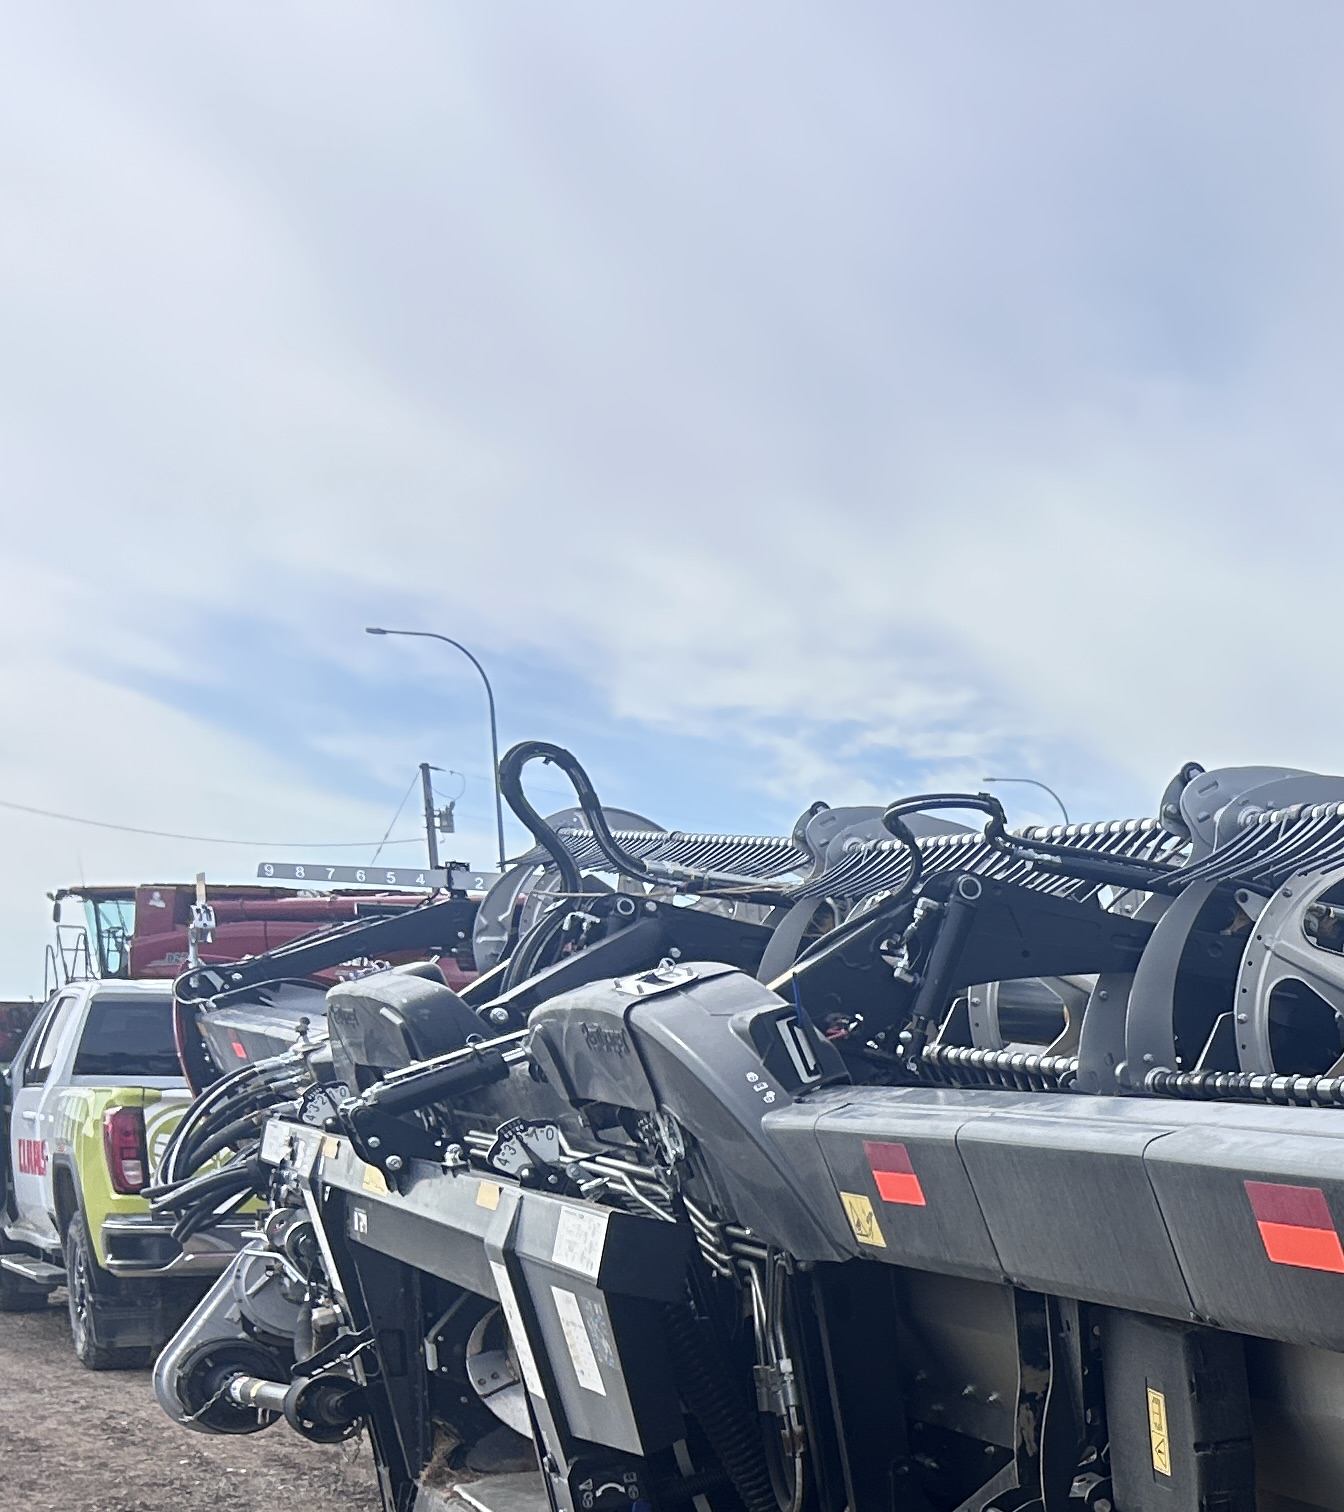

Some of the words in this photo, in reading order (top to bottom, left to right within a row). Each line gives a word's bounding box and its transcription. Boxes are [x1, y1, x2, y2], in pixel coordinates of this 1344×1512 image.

[264, 864, 275, 876] 9
[295, 866, 305, 878] 8
[325, 867, 336, 880] 7
[356, 869, 366, 882] 6
[386, 871, 396, 884] 5
[415, 873, 426, 885] 4
[474, 876, 484, 889] 2
[545, 1127, 555, 1141] 0
